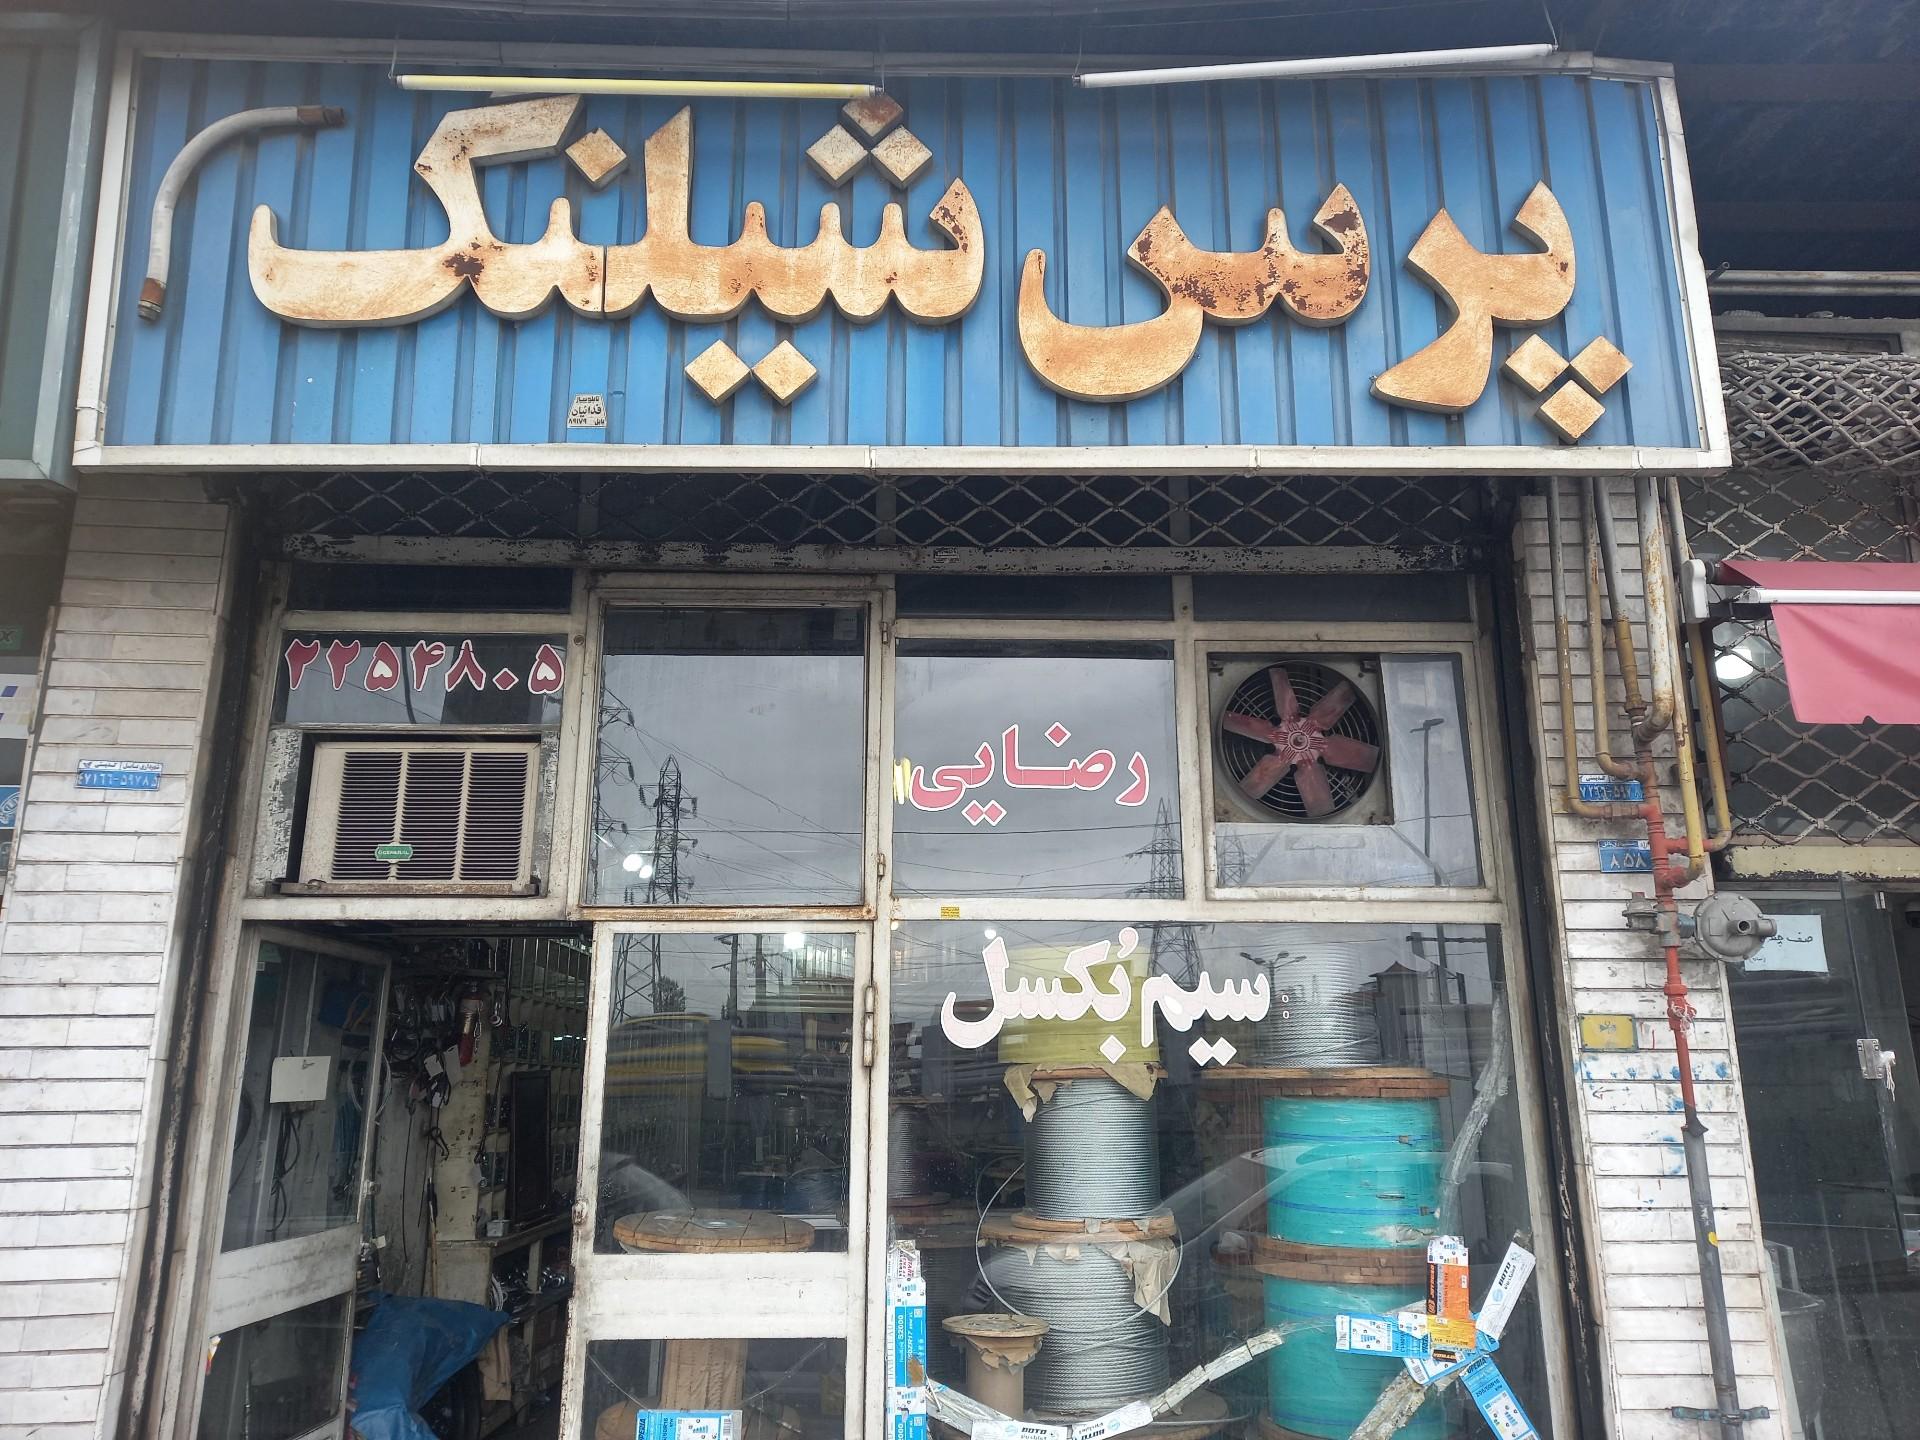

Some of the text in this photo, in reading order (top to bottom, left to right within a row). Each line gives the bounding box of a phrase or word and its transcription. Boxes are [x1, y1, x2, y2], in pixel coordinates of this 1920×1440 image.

[248, 91, 1633, 444] پرس شیلنگ
[284, 638, 565, 695] ۲۲۵۴۸۰۵
[909, 721, 1150, 826] رضایی
[1141, 971, 1271, 1067] سیم
